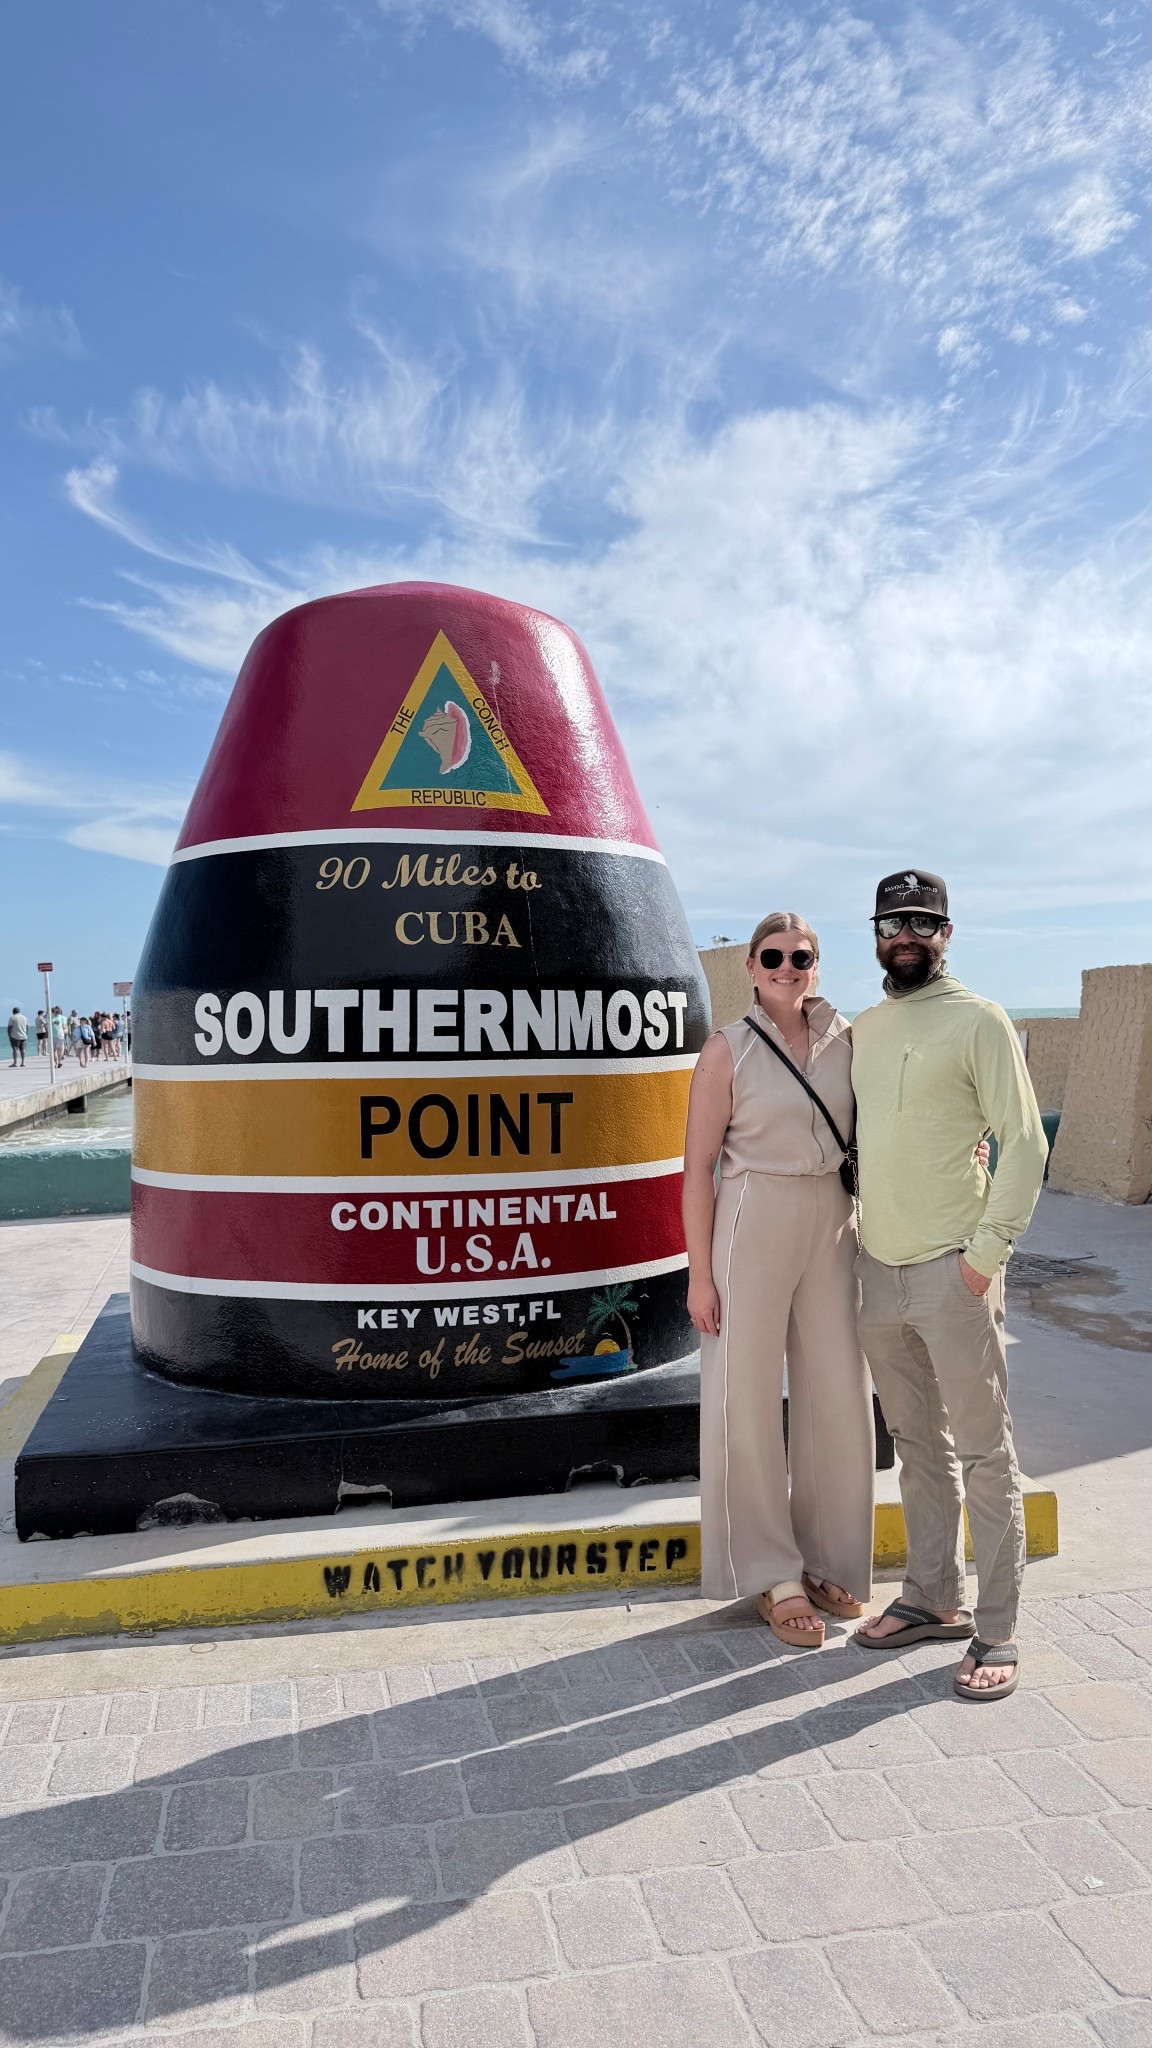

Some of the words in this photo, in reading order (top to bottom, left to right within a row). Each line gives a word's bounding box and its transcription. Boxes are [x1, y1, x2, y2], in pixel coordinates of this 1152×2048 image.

[391, 706, 415, 735] THE
[472, 697, 510, 751] CONCH
[411, 789, 487, 806] REPUBLIC
[315, 857, 369, 890] 90
[381, 853, 497, 889] Miles
[506, 859, 542, 890] to
[394, 911, 522, 948] CUBA
[194, 989, 688, 1056] SOUTHERNMOST
[359, 1092, 574, 1159] POINT
[331, 1192, 617, 1231] CONTINENTAL
[416, 1232, 551, 1275] U.S.A.
[357, 1308, 421, 1329] KEY
[331, 1338, 409, 1371] Home
[420, 1337, 446, 1379] of
[454, 1332, 492, 1366] the
[501, 1328, 586, 1364] Sunset
[323, 1552, 464, 1598] WATCH
[478, 1543, 577, 1580] YOUR
[586, 1538, 688, 1574] STEP
